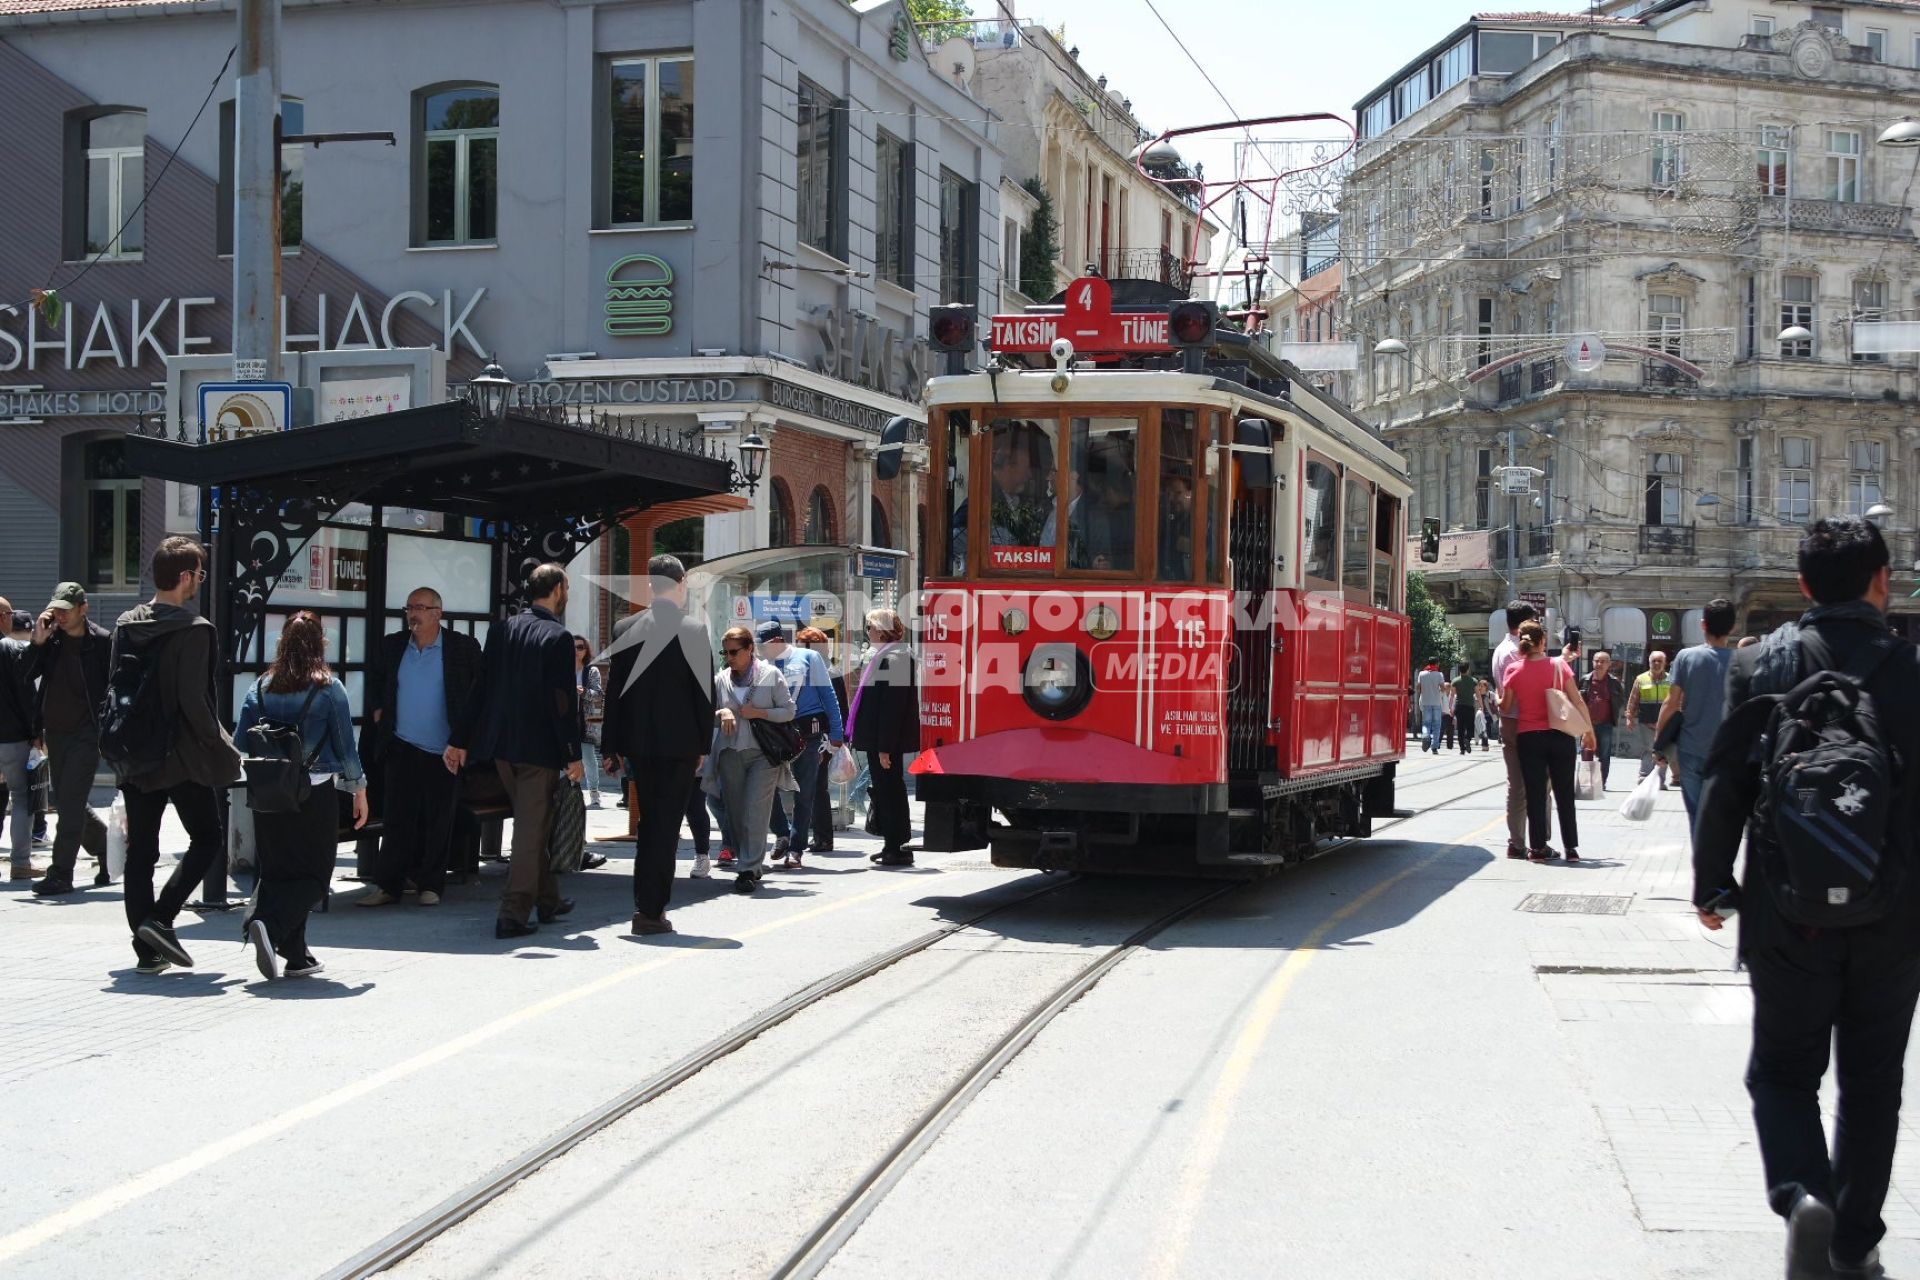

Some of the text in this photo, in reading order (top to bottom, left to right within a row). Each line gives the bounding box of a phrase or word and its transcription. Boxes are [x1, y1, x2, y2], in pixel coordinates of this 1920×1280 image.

[1079, 283, 1092, 311] 4
[0, 286, 490, 371] SHAKE HACK
[992, 318, 1058, 346] TAKSİM
[1120, 316, 1169, 345] TÜNE
[0, 392, 80, 415] SHAKES
[97, 392, 142, 414] HOT
[516, 378, 736, 405] FROZEN CUSTARD
[772, 381, 815, 416] BURGERS
[822, 396, 855, 425] FROZEN
[857, 407, 891, 431] CUSTAR
[333, 556, 367, 580] TÜNEL
[994, 549, 1051, 564] TAKSİM
[926, 613, 948, 641] 115
[1174, 619, 1207, 649] 115
[1160, 723, 1172, 735] VE
